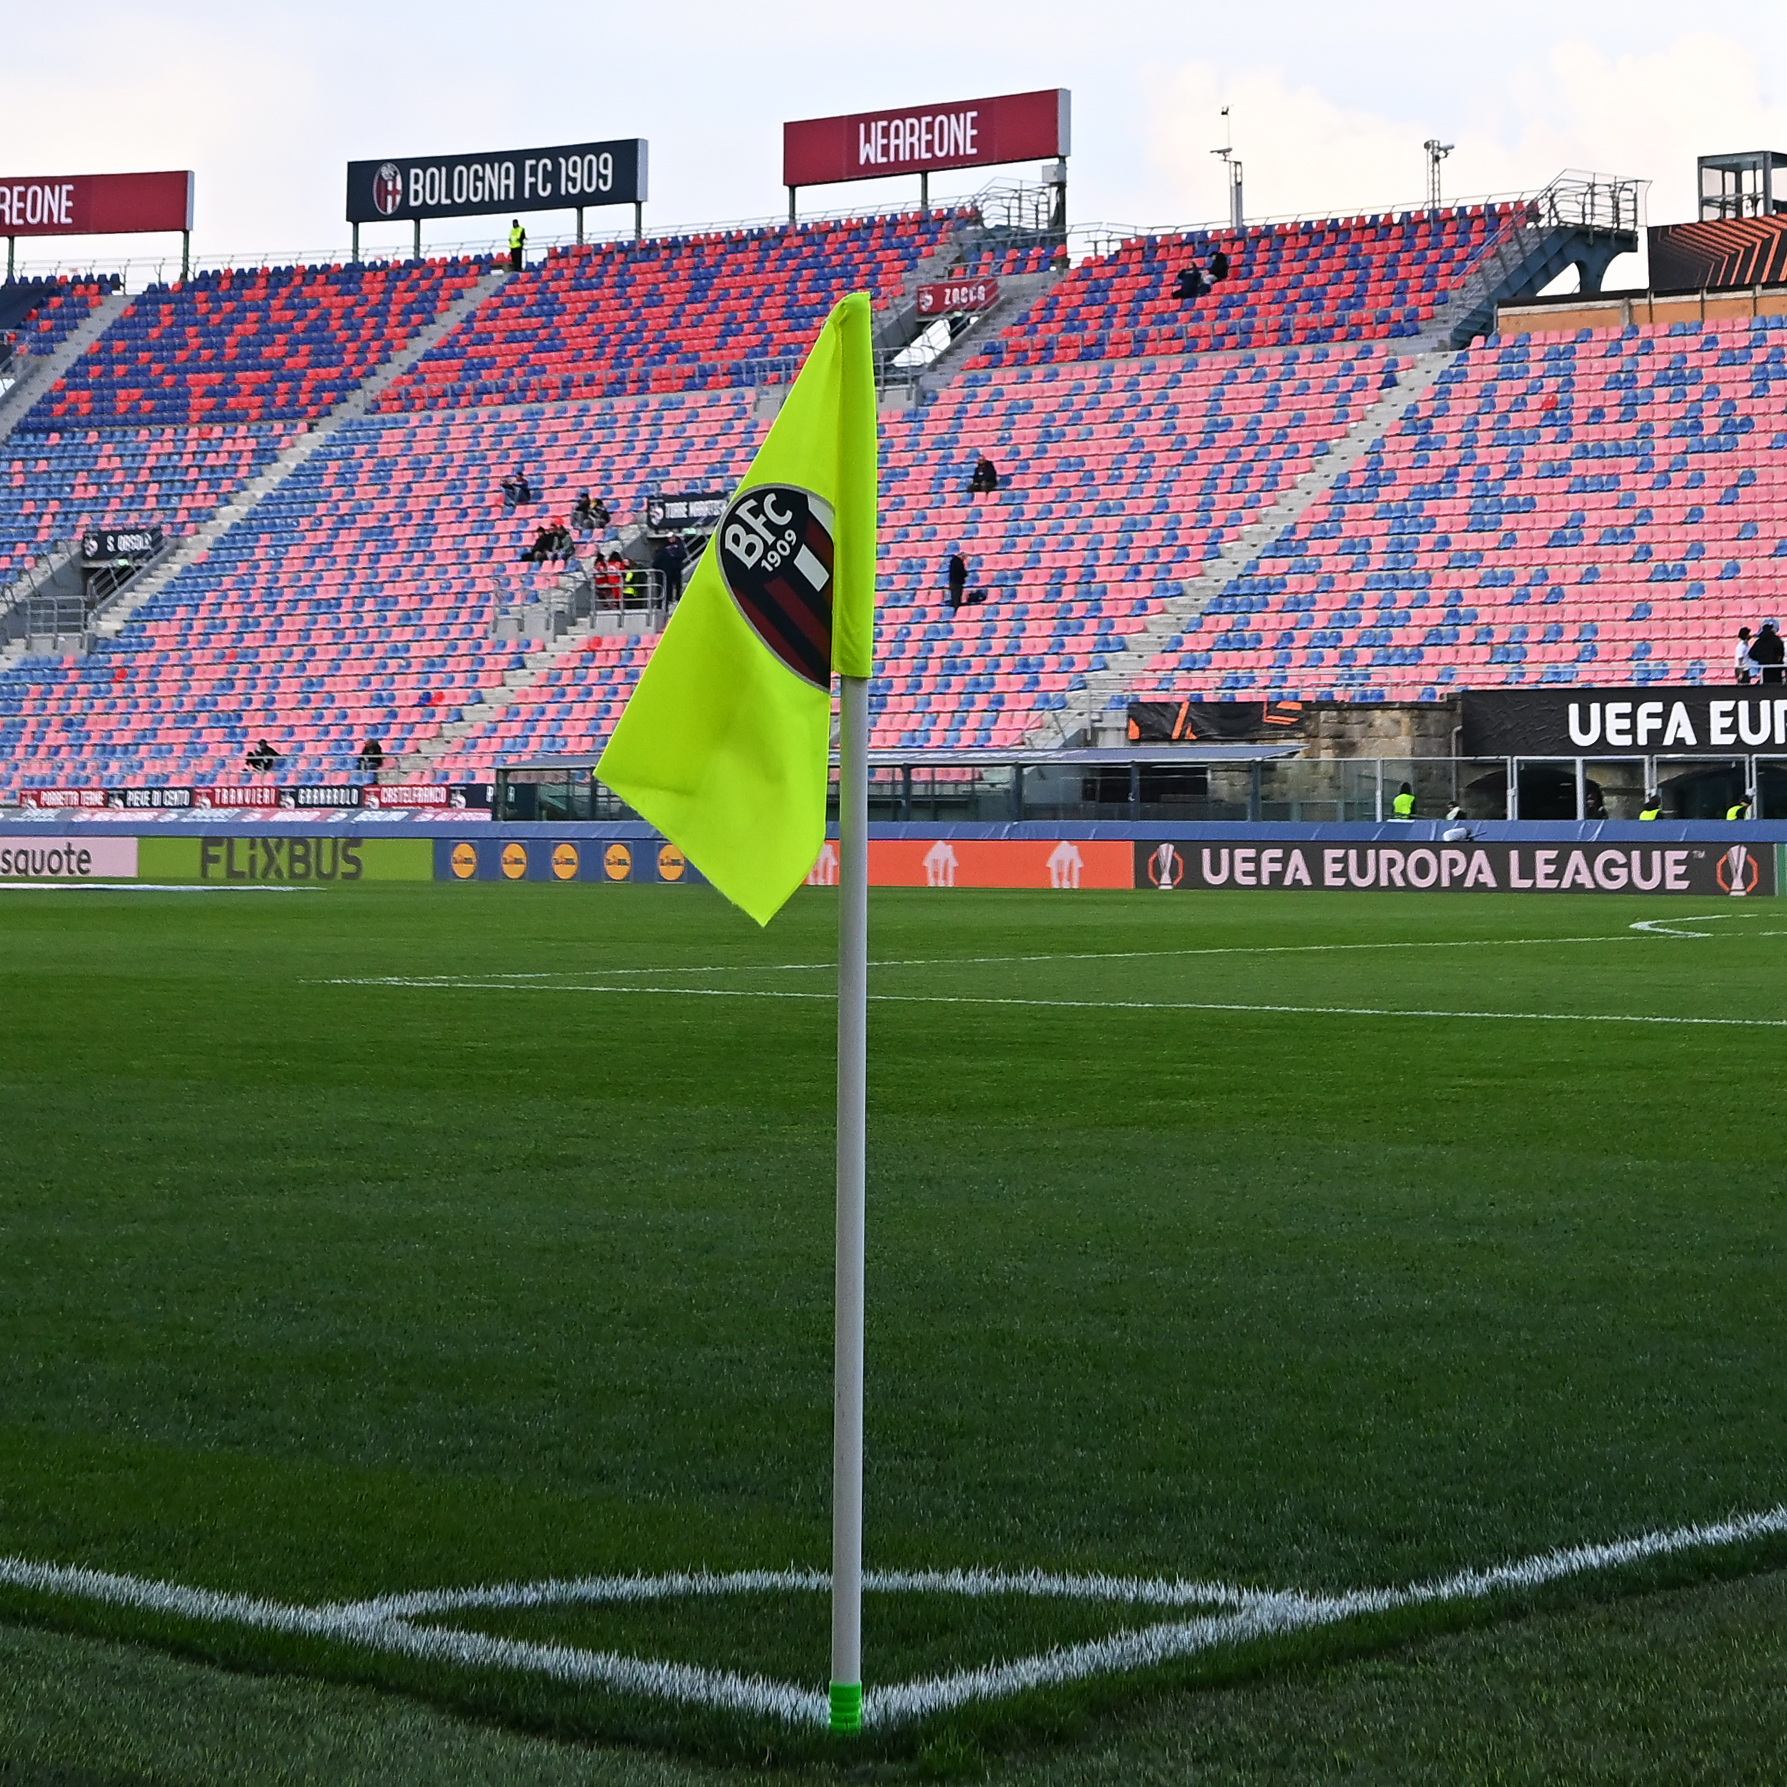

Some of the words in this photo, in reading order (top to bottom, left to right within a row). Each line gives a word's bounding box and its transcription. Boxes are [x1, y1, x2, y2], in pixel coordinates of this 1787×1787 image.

[859, 111, 978, 165] WEAREONE
[409, 161, 514, 207] BOLOGNA
[525, 159, 552, 199] FC
[558, 152, 613, 194] 1909
[725, 493, 793, 571] BFC
[761, 529, 797, 572] 1909
[1568, 701, 1698, 748] UEFA
[1202, 848, 1313, 886] UEFA
[1323, 848, 1498, 888] EUROPA
[1508, 849, 1691, 891] LEAGUE
